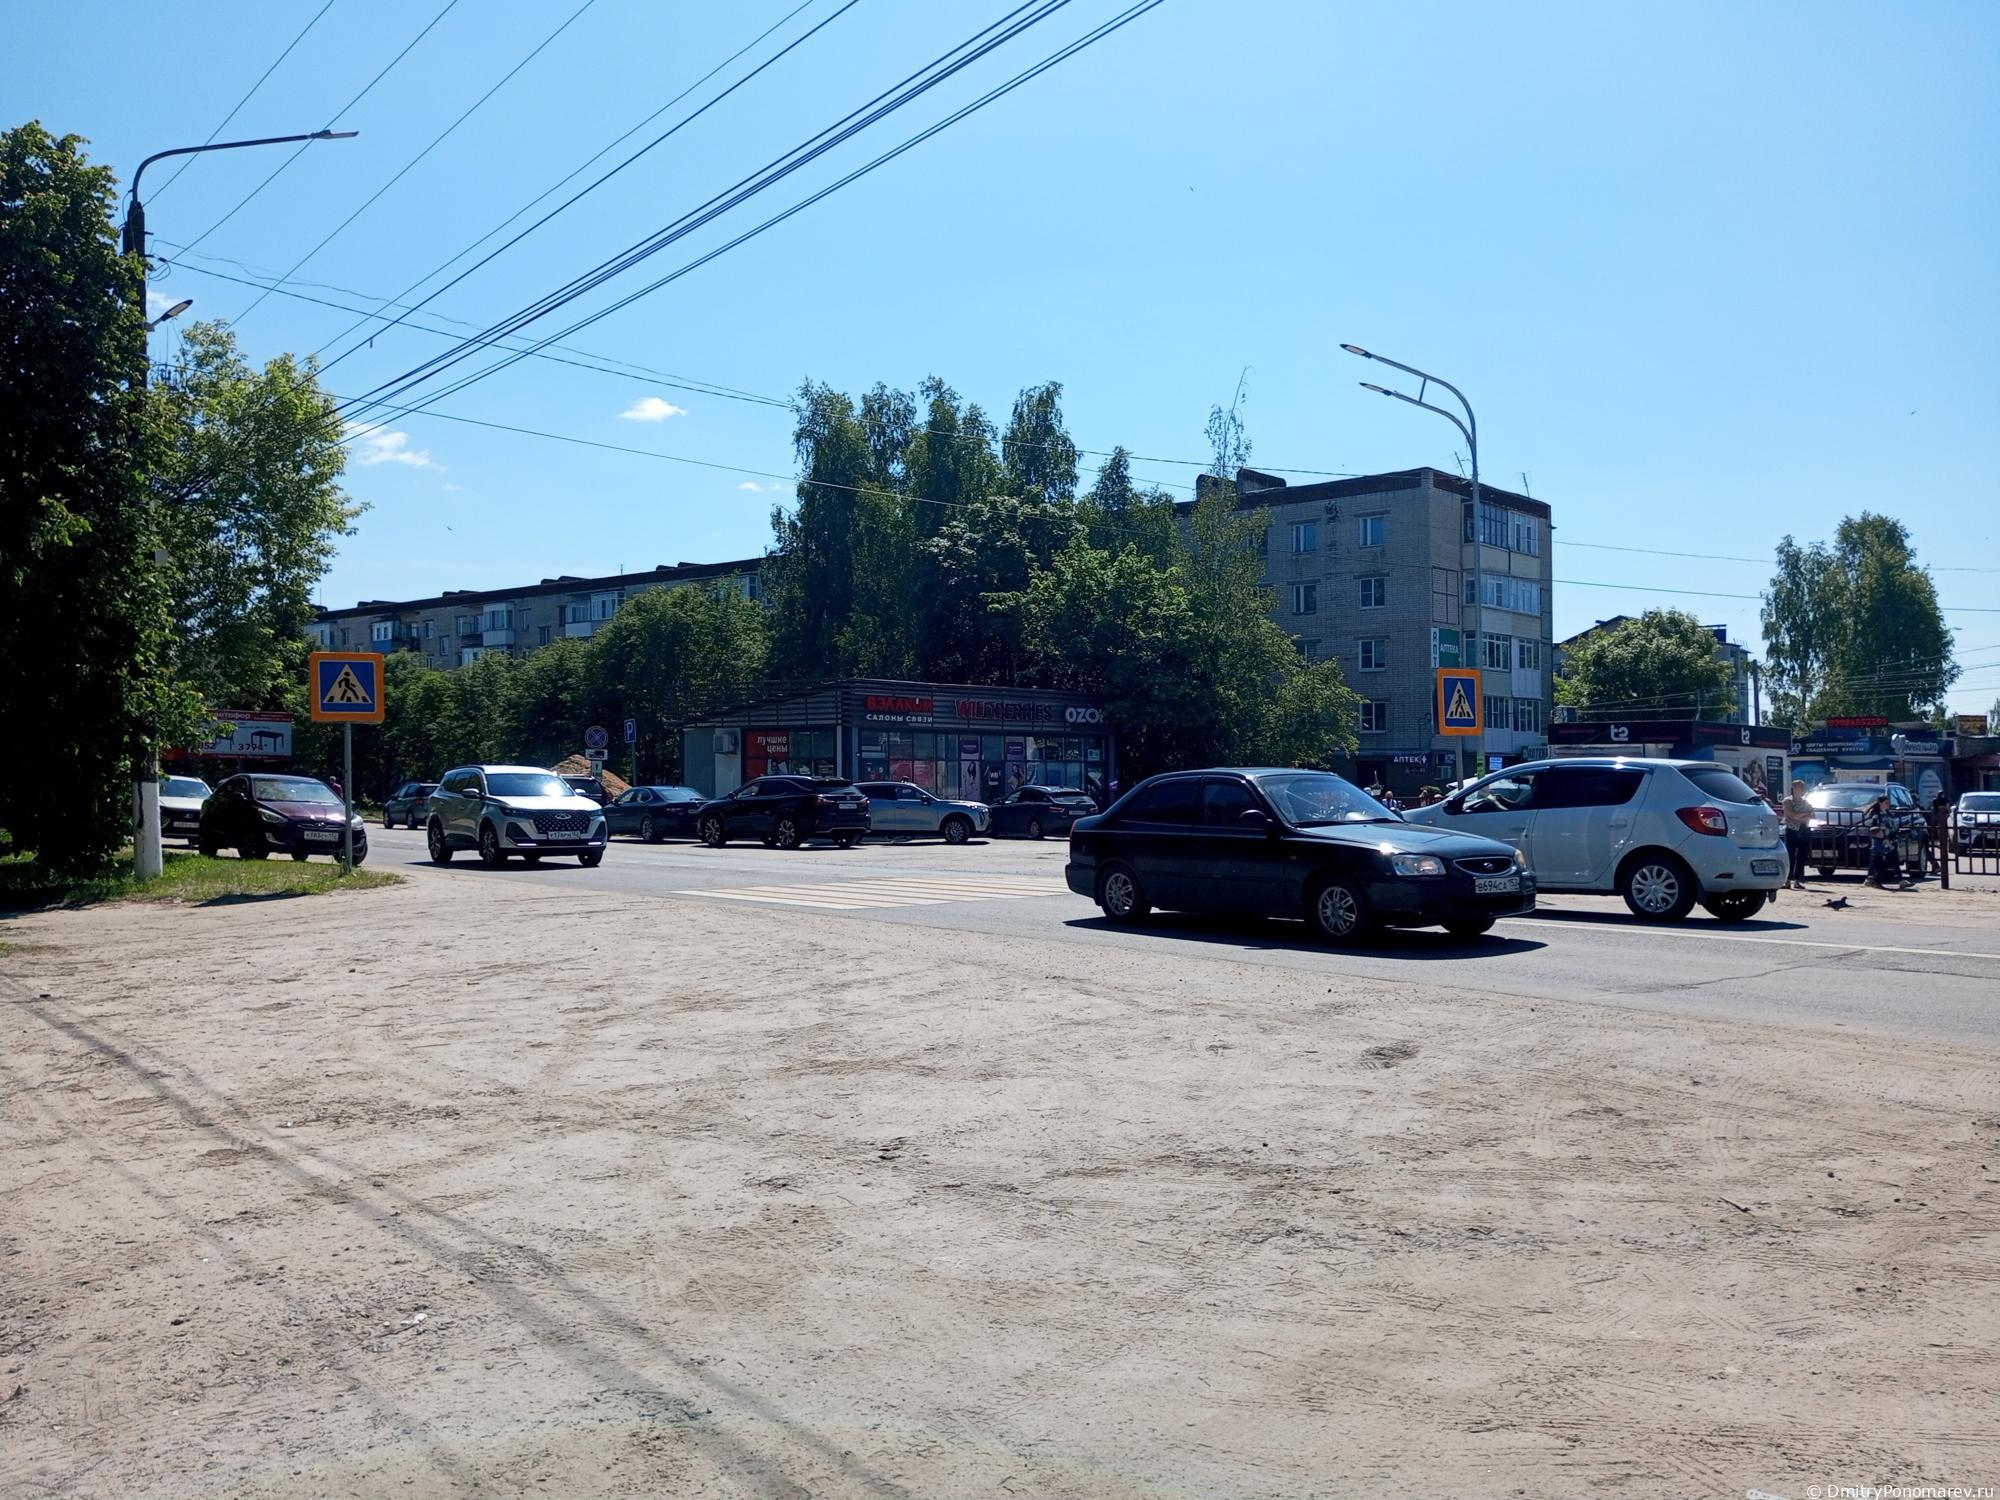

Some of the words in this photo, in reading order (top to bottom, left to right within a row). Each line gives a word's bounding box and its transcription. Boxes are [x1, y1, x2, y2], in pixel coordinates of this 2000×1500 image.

[1440, 643, 1459, 655] АПТЕКА
[866, 713, 903, 722] САЛОНЫ
[906, 715, 933, 723] СВЯЗИ
[757, 736, 788, 746] лучшие
[767, 745, 788, 755] цены
